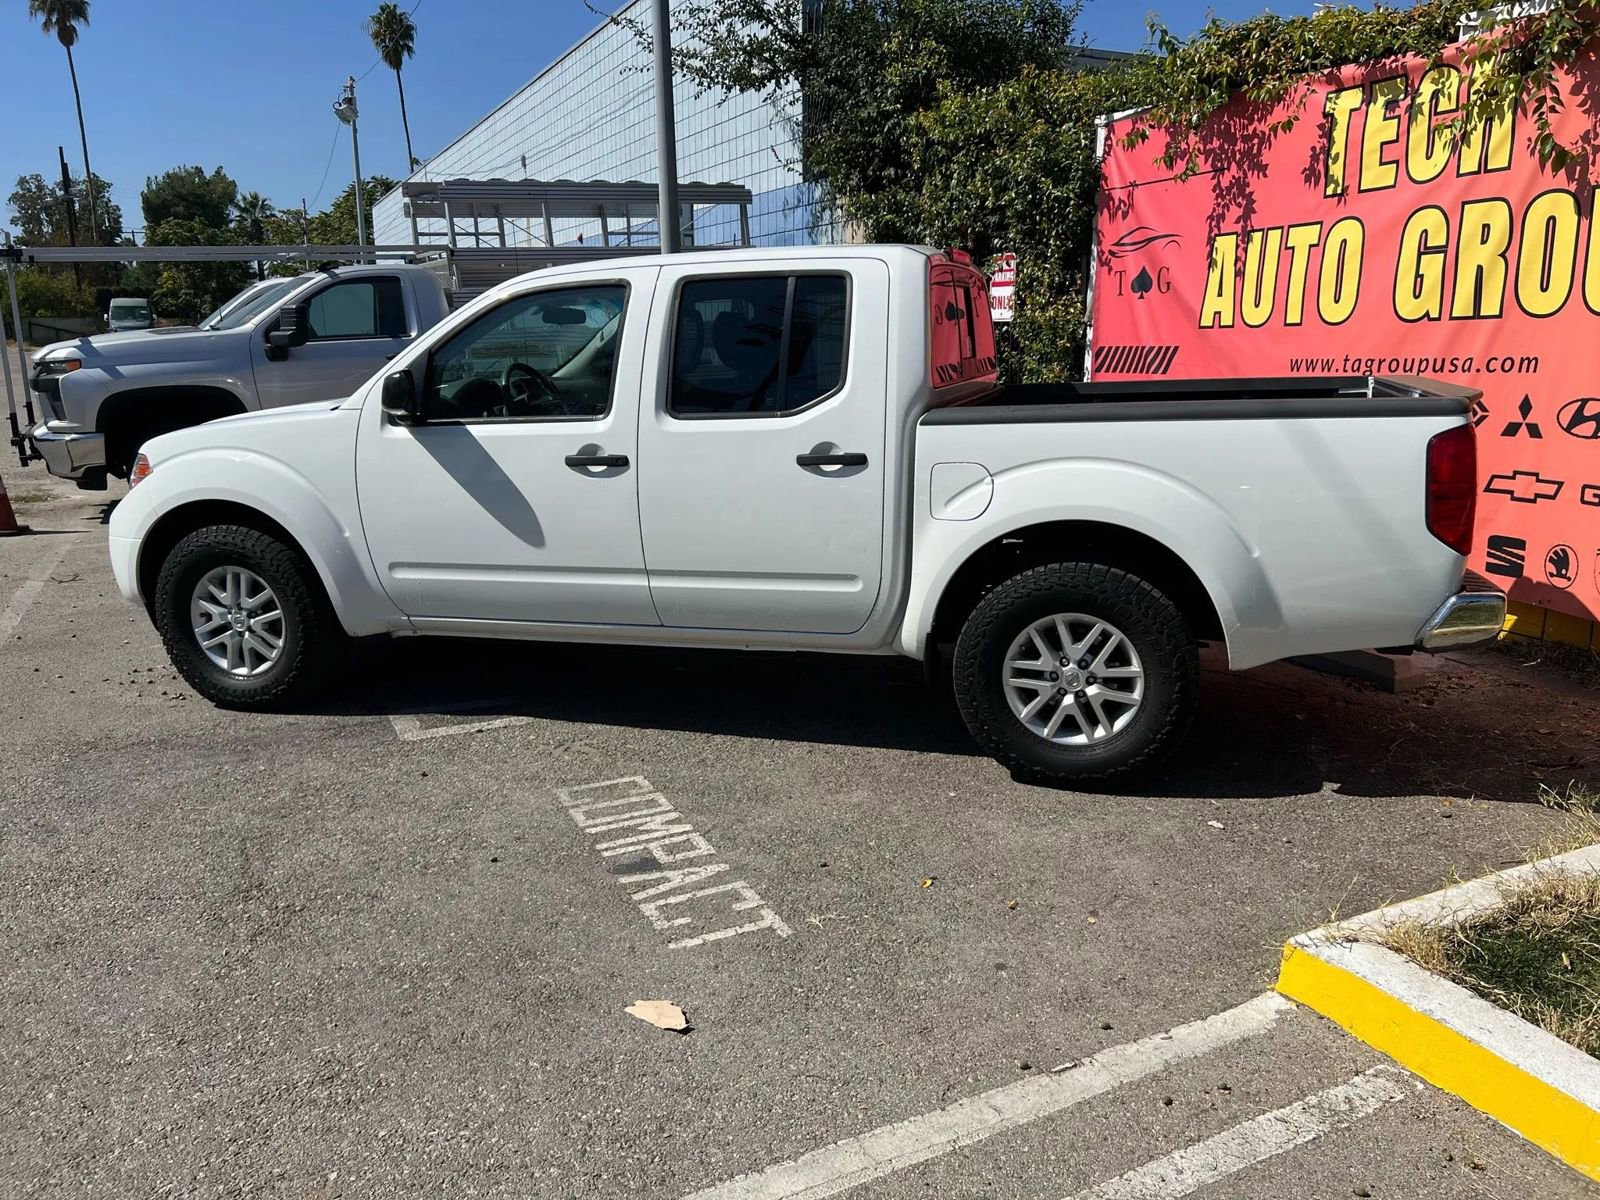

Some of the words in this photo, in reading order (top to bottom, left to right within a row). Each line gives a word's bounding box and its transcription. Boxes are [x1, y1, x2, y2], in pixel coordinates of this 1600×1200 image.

[1199, 216, 1365, 329] AUTO
[1290, 354, 1539, 376] www.tagroupusa.com
[554, 775, 794, 949] COMPACT
